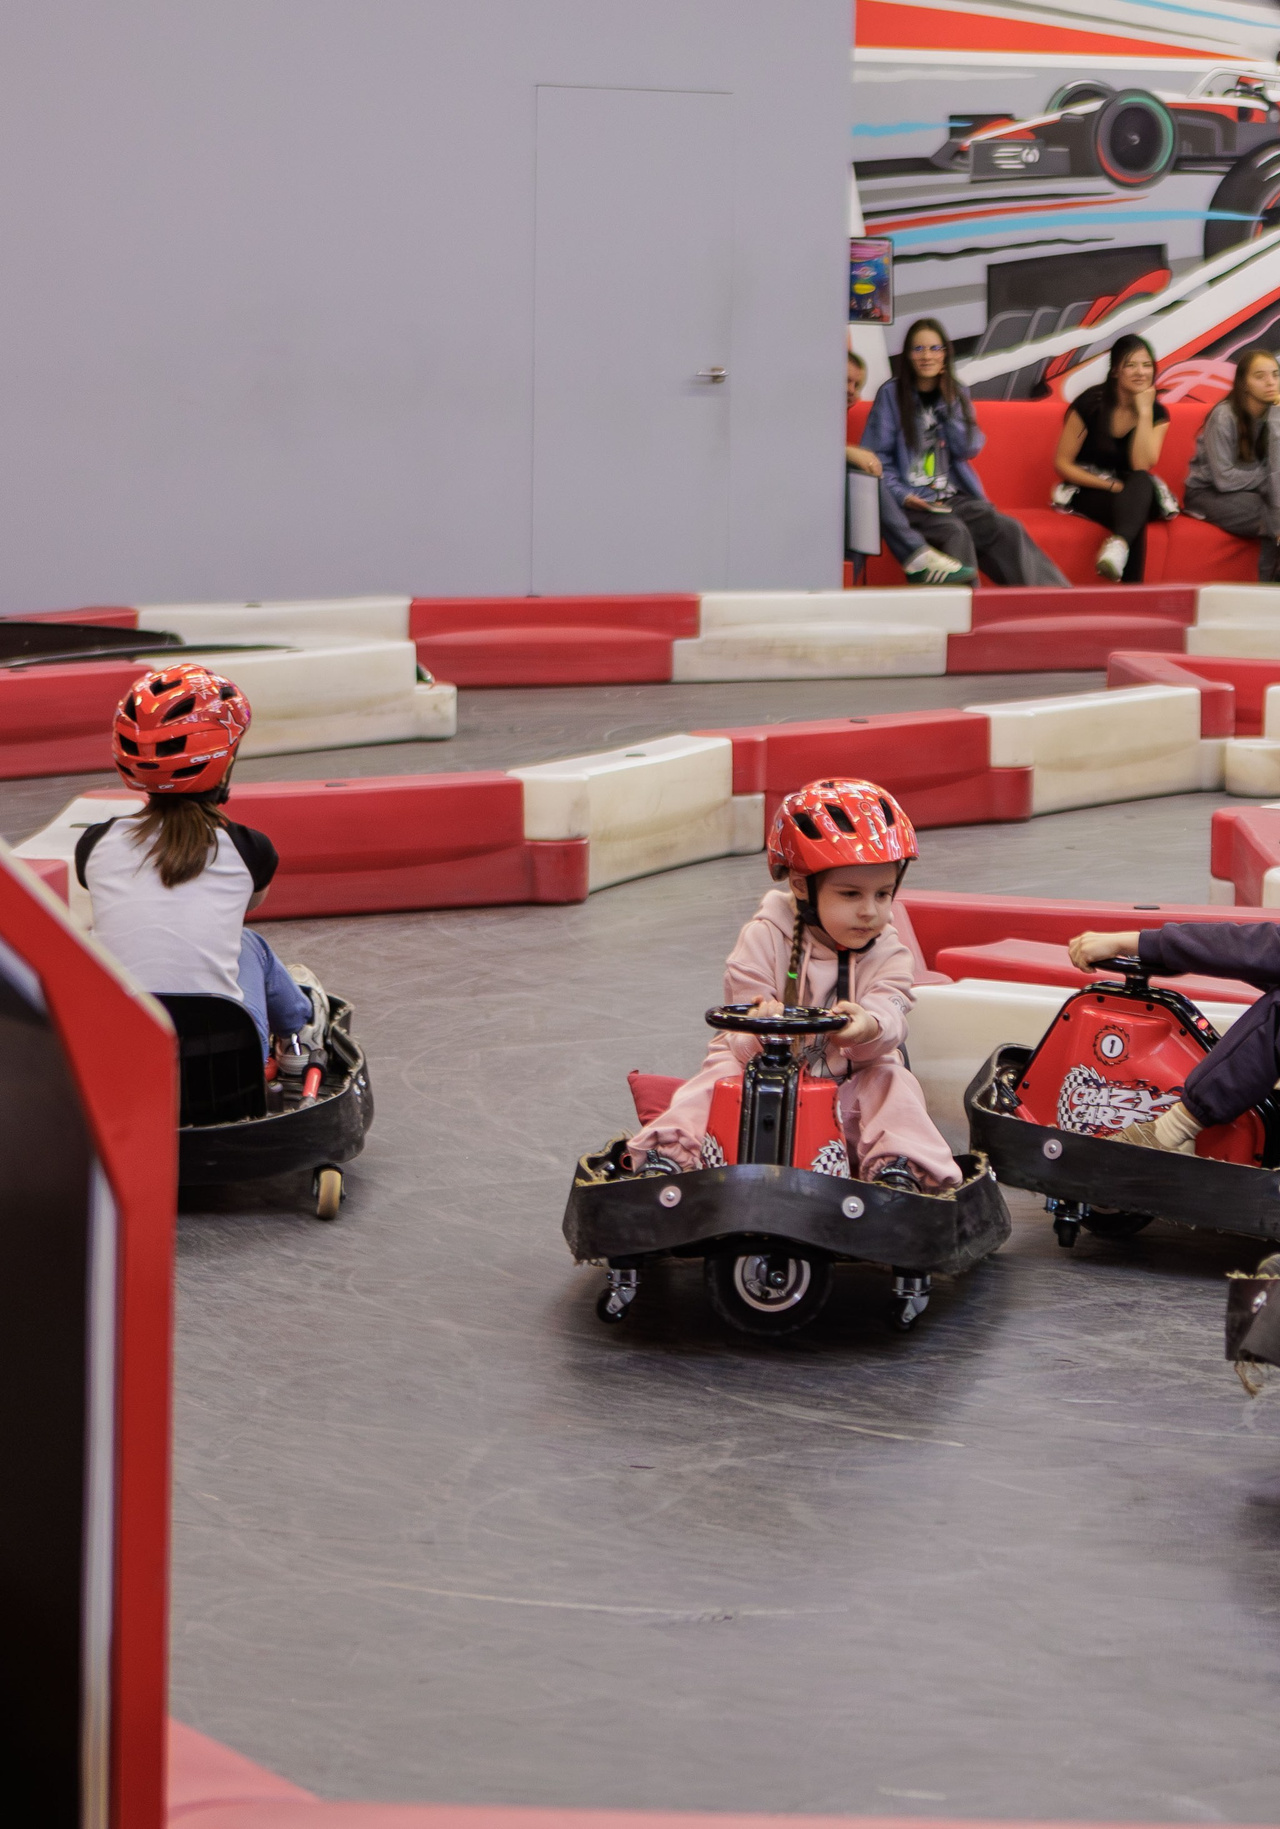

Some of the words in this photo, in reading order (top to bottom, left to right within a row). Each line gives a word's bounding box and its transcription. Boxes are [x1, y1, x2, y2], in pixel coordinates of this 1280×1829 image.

[1109, 1039, 1117, 1054] 1
[1071, 1085, 1181, 1115] CRAZY
[1071, 1104, 1147, 1129] CART
